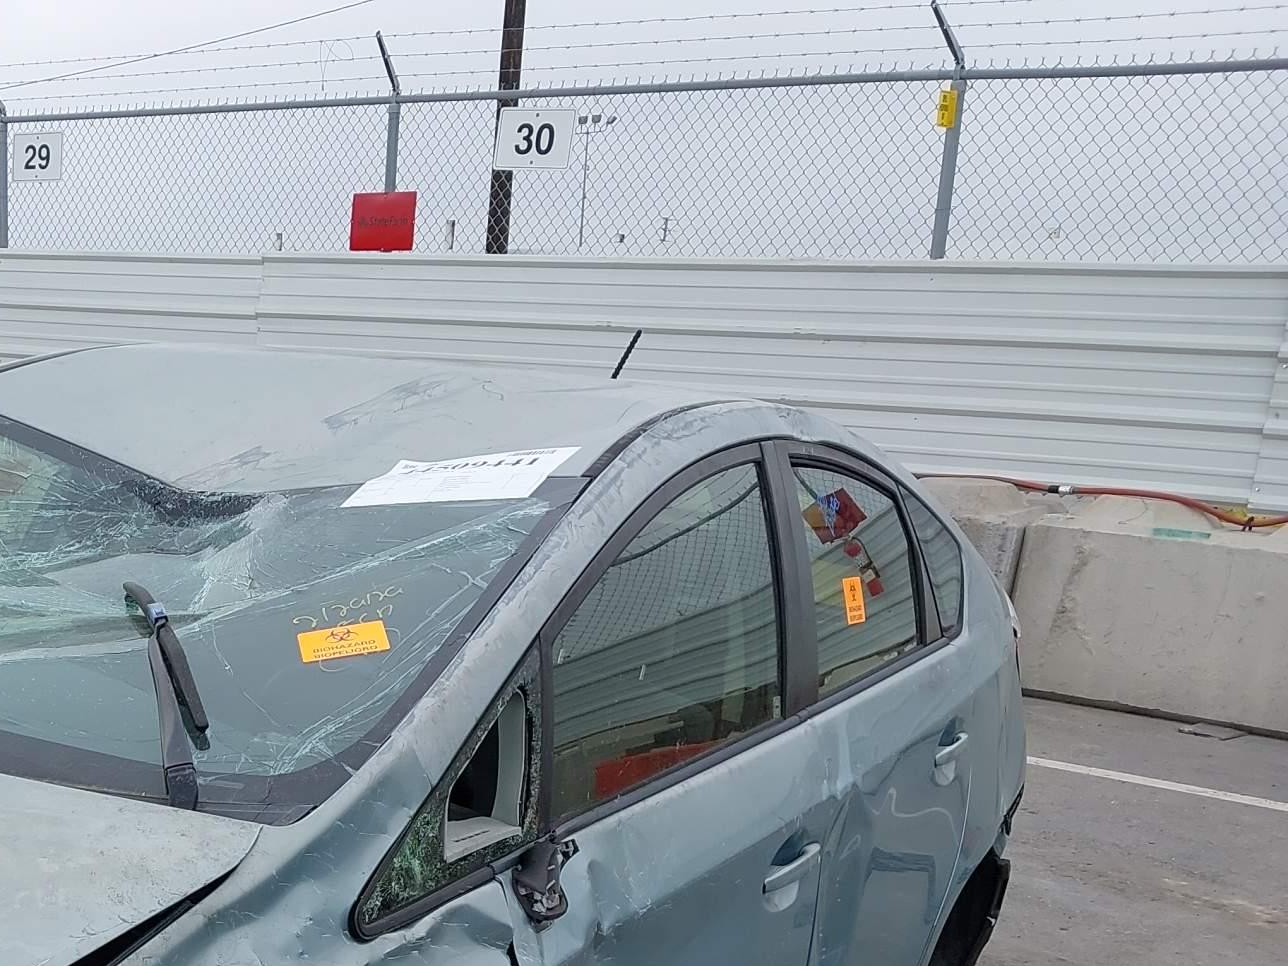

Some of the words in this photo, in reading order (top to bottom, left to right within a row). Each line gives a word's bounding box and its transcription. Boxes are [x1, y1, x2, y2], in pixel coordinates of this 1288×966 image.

[514, 122, 555, 155] 30
[24, 143, 51, 170] 29
[312, 639, 376, 654] BIOHAZARD
